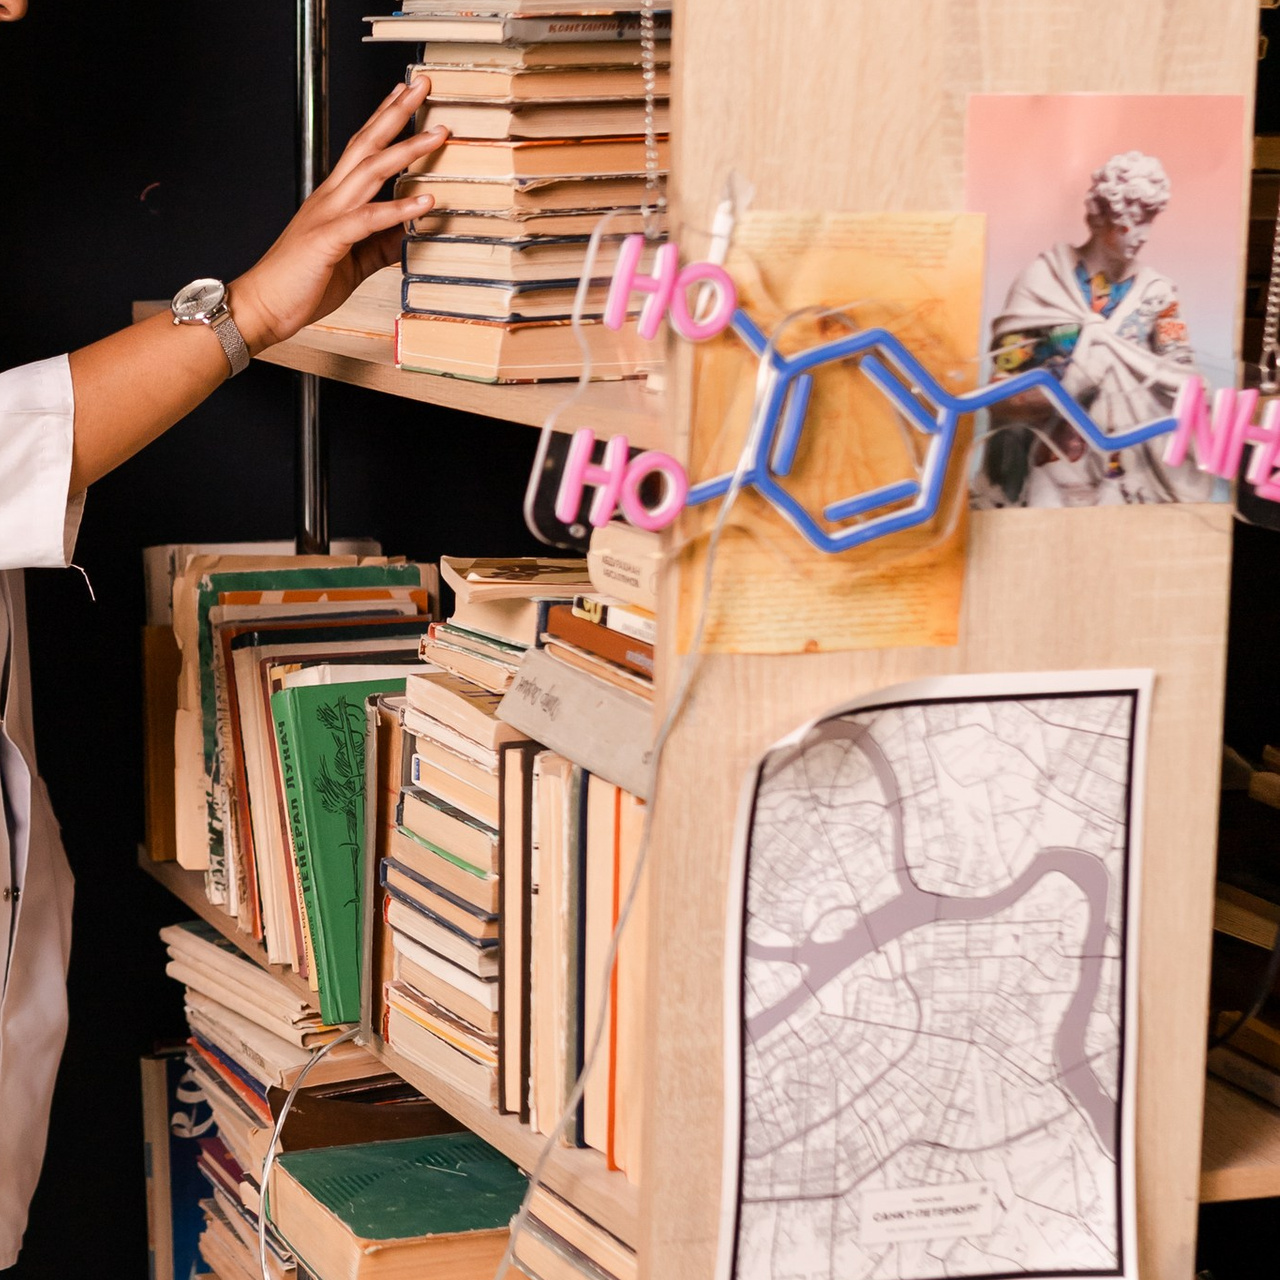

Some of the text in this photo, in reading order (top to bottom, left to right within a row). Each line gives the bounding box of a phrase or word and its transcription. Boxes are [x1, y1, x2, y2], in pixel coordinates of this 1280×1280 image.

[603, 234, 738, 342] HO
[554, 427, 688, 531] HO
[277, 720, 311, 893] ГЕНЕРАЛ ЛУКАЧ
